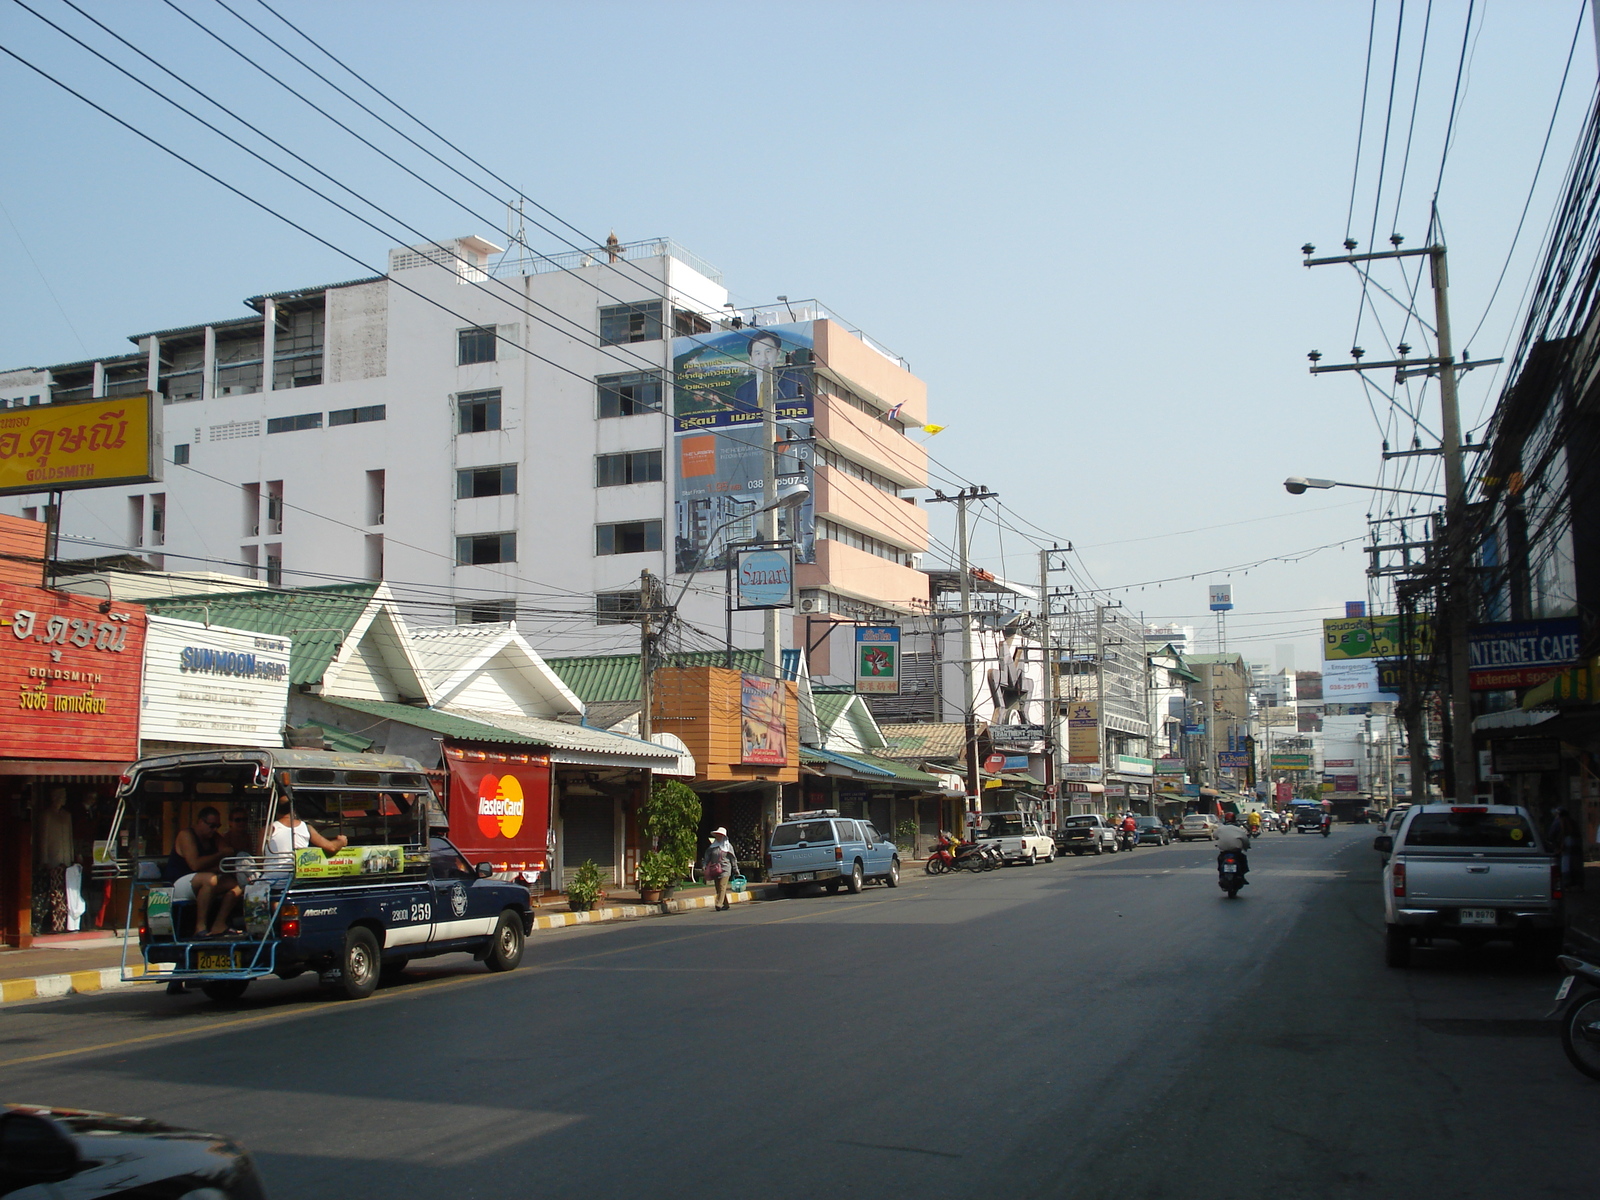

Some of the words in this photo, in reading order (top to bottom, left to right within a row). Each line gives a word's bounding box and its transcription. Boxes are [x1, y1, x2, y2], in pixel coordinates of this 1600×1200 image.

[26, 464, 95, 481] GOLDSMITH
[740, 562, 790, 586] Smart
[1210, 593, 1230, 602] TMB
[12, 609, 131, 663] อ.ดุษณี
[1540, 634, 1579, 661] CAFE
[29, 667, 102, 683] GOLDSMITH
[1476, 671, 1522, 686] internet
[478, 797, 524, 816] MasterCard
[411, 902, 431, 922] 259
